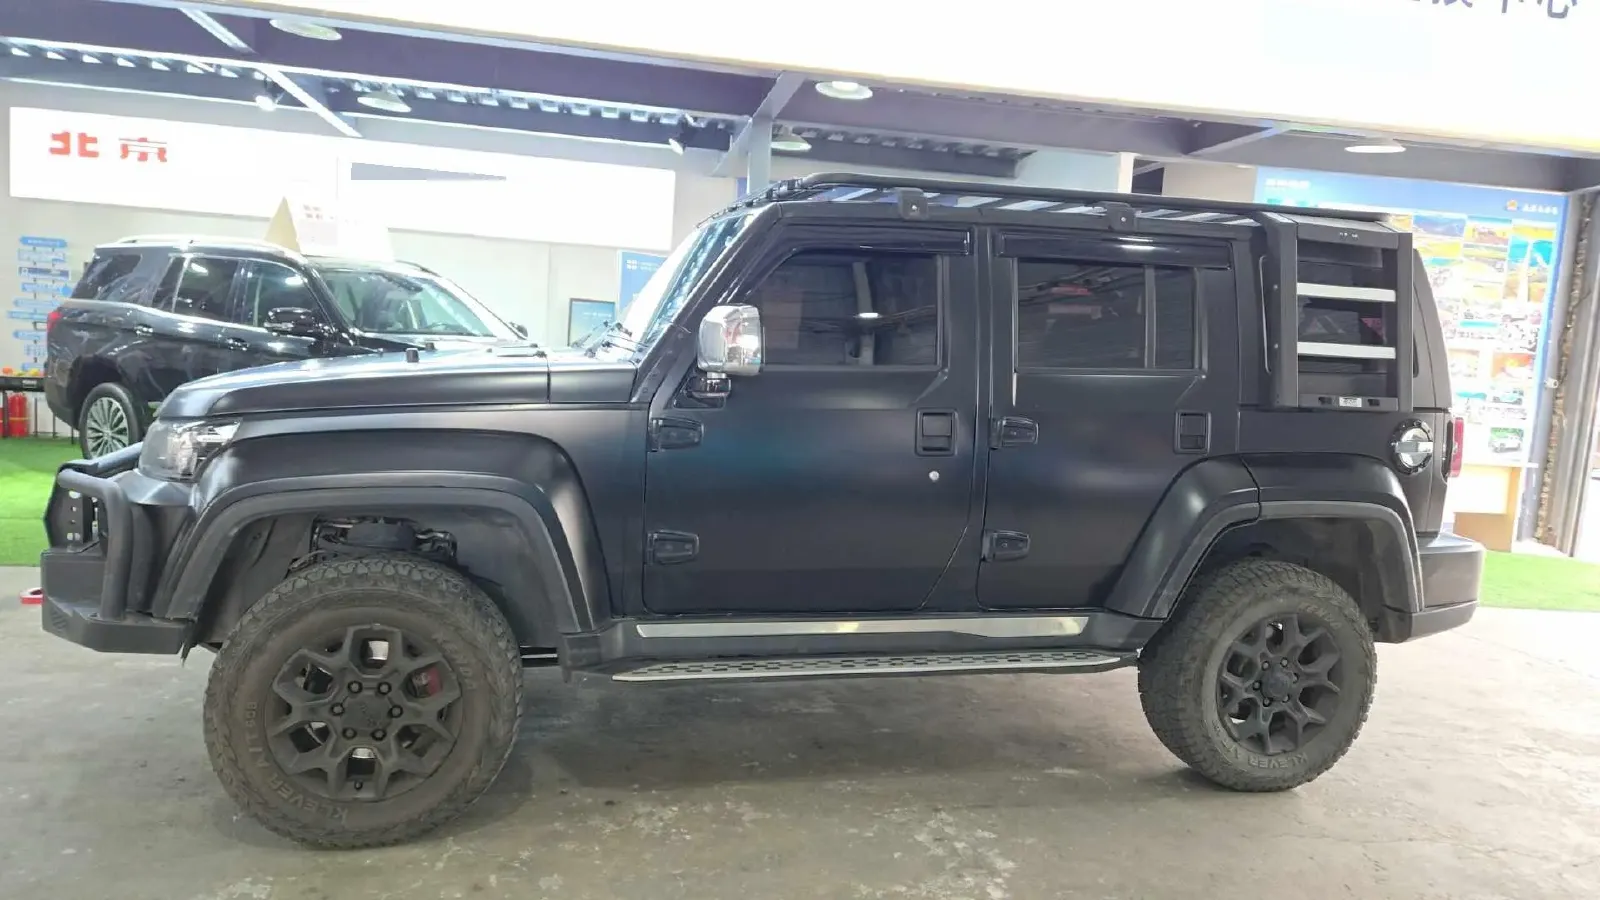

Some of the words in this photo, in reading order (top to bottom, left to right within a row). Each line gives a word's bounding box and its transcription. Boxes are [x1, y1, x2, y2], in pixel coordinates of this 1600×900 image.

[49, 131, 167, 163] 北京
[1248, 752, 1308, 769] KLEVER
[269, 773, 347, 824] KLEVER
